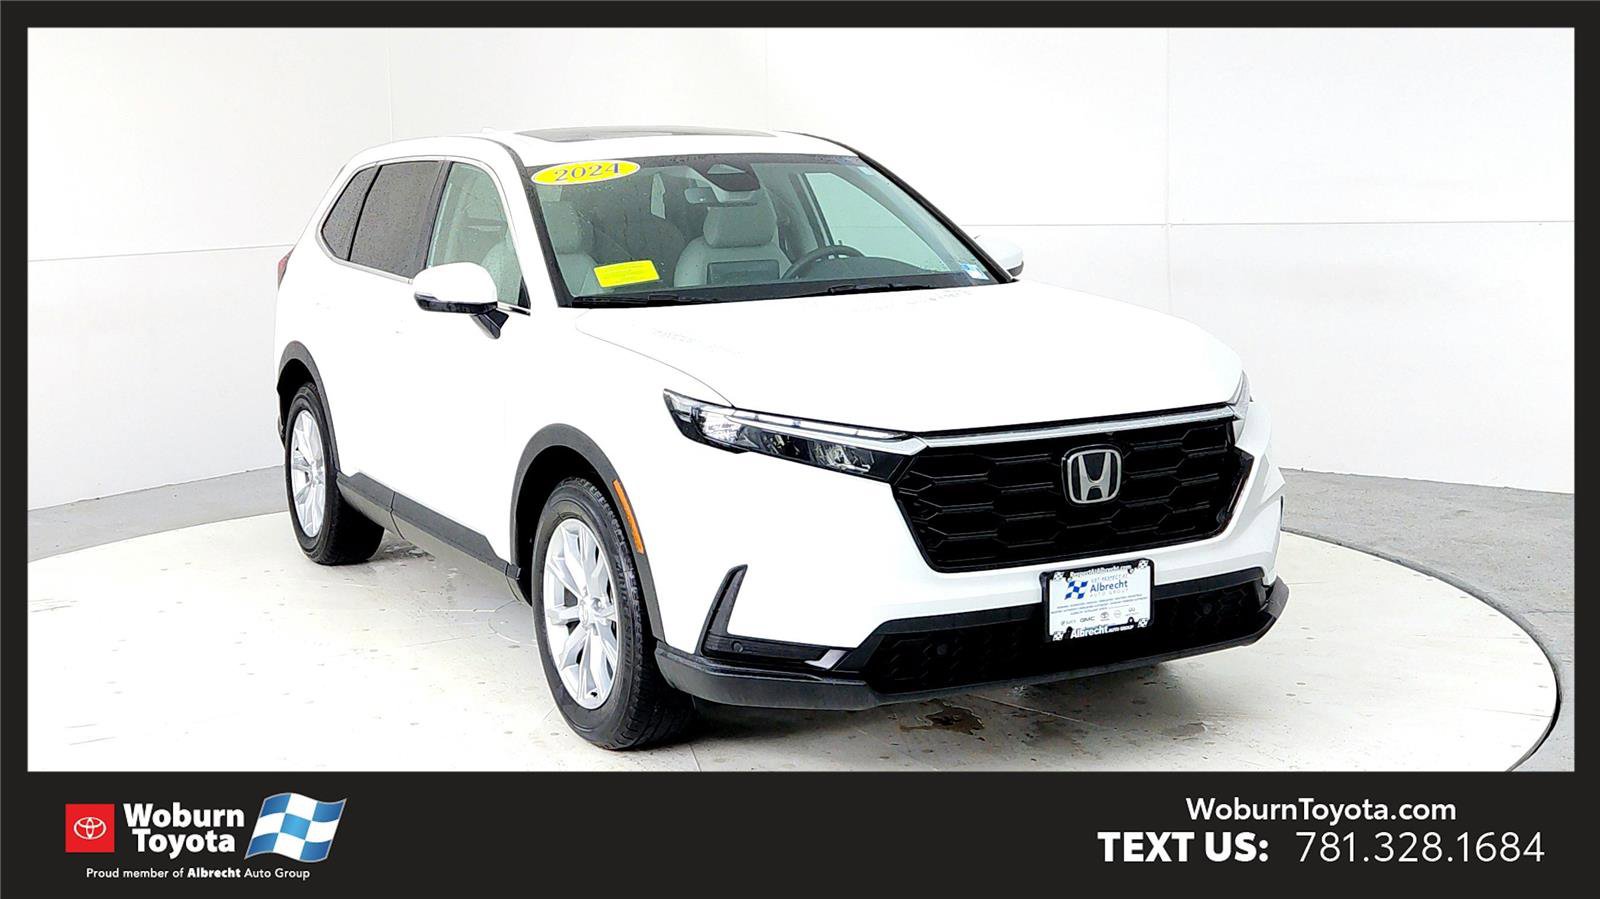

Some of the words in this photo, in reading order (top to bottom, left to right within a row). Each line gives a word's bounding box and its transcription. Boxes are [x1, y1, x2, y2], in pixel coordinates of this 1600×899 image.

[554, 162, 620, 182] 2024
[1090, 579, 1128, 593] Albrecht
[1070, 624, 1109, 639] Albrecht
